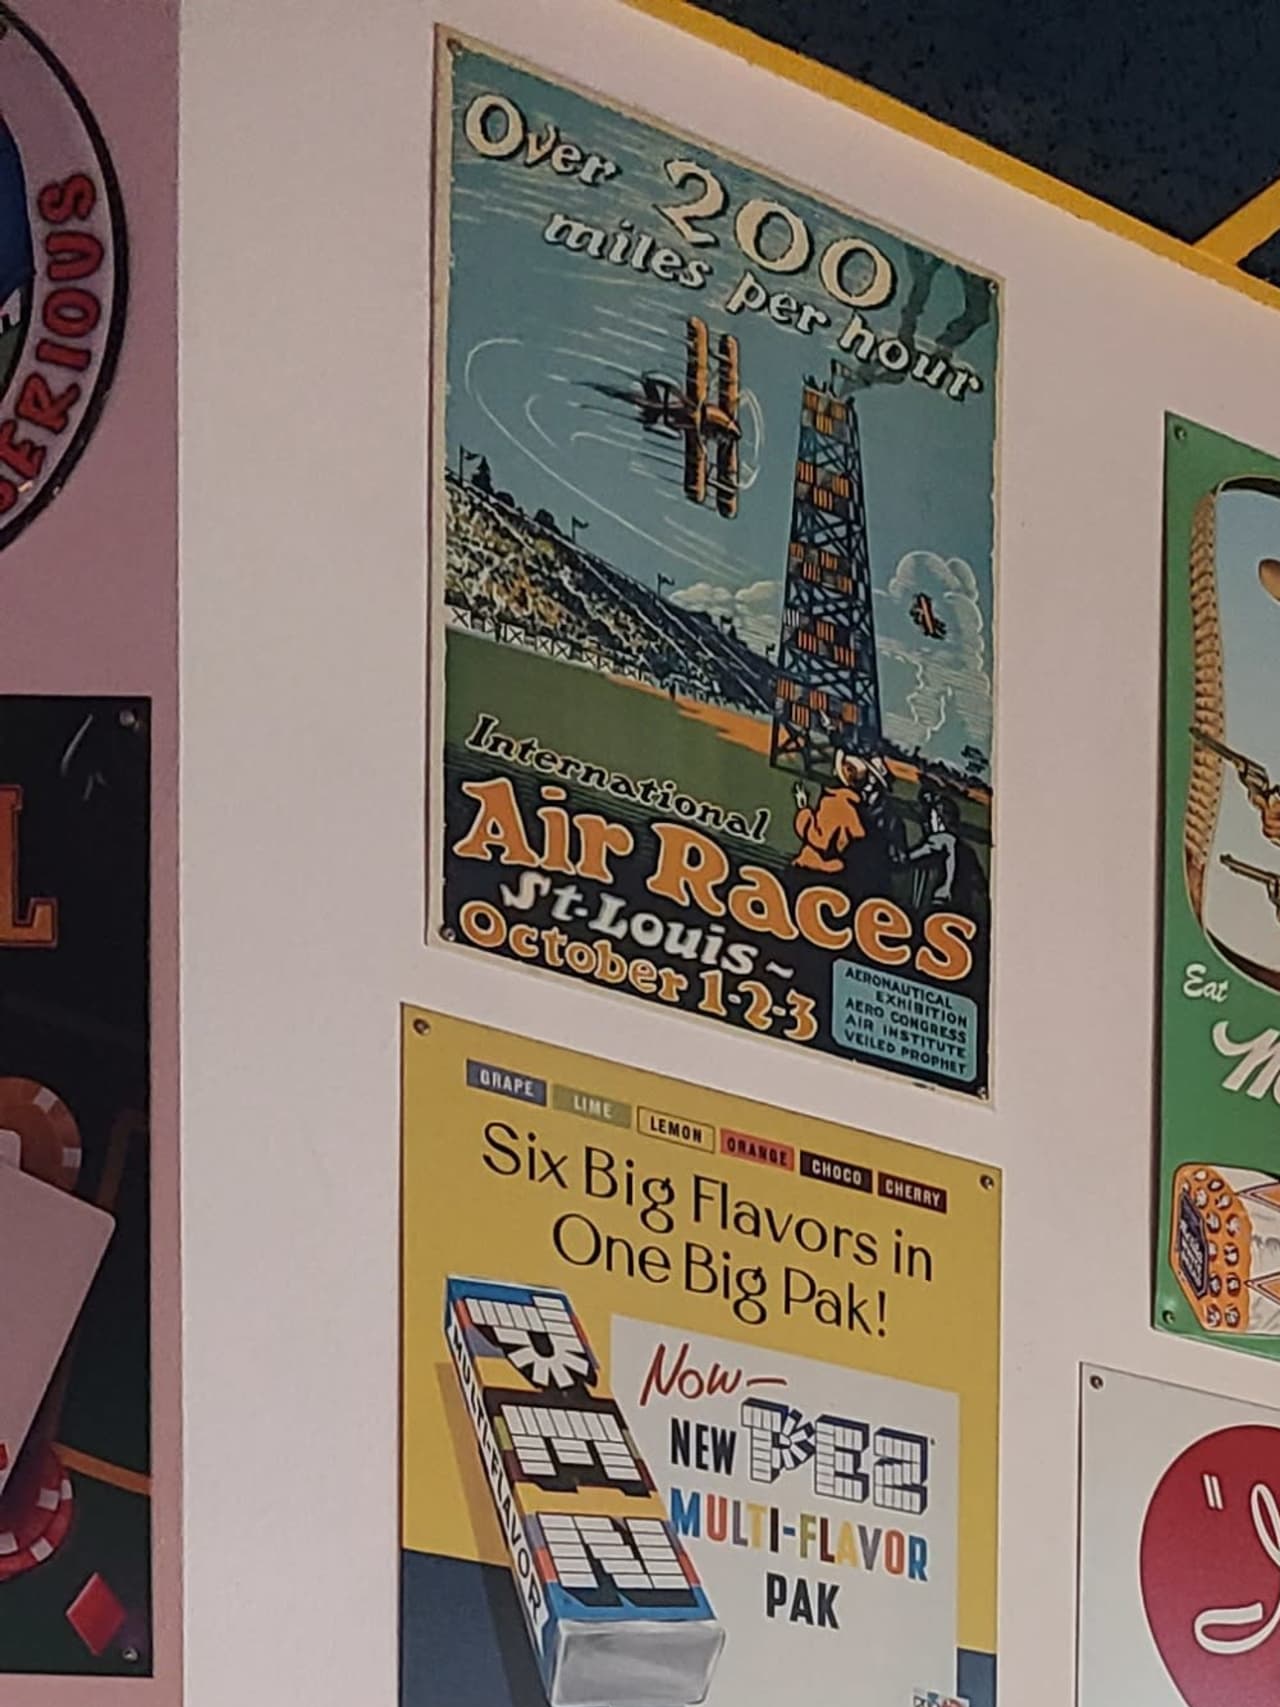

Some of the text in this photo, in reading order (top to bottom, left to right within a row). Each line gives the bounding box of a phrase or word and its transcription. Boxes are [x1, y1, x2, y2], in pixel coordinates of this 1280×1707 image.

[465, 92, 897, 310] Over 200
[543, 211, 983, 401] miles per hour
[464, 712, 772, 844] International
[453, 777, 976, 982] Air Races
[459, 901, 688, 1004] October
[845, 967, 954, 1010] AERONAUTICAL
[1181, 962, 1229, 1003] Eat
[844, 1030, 967, 1075] VEILED PROPHET
[845, 997, 967, 1044] AERO CONGRESS
[875, 990, 967, 1029] EXHIBITION
[883, 1023, 966, 1059] INSTITUTE
[481, 1120, 933, 1283] Six Big Flavors in
[648, 1114, 943, 1209] LEMON CHOCO CHERRY
[551, 1212, 890, 1338] One Big Pak!
[669, 1416, 738, 1476] NEW
[669, 1486, 929, 1583] MULTI-FLAVOR
[765, 1571, 841, 1630] PAK
